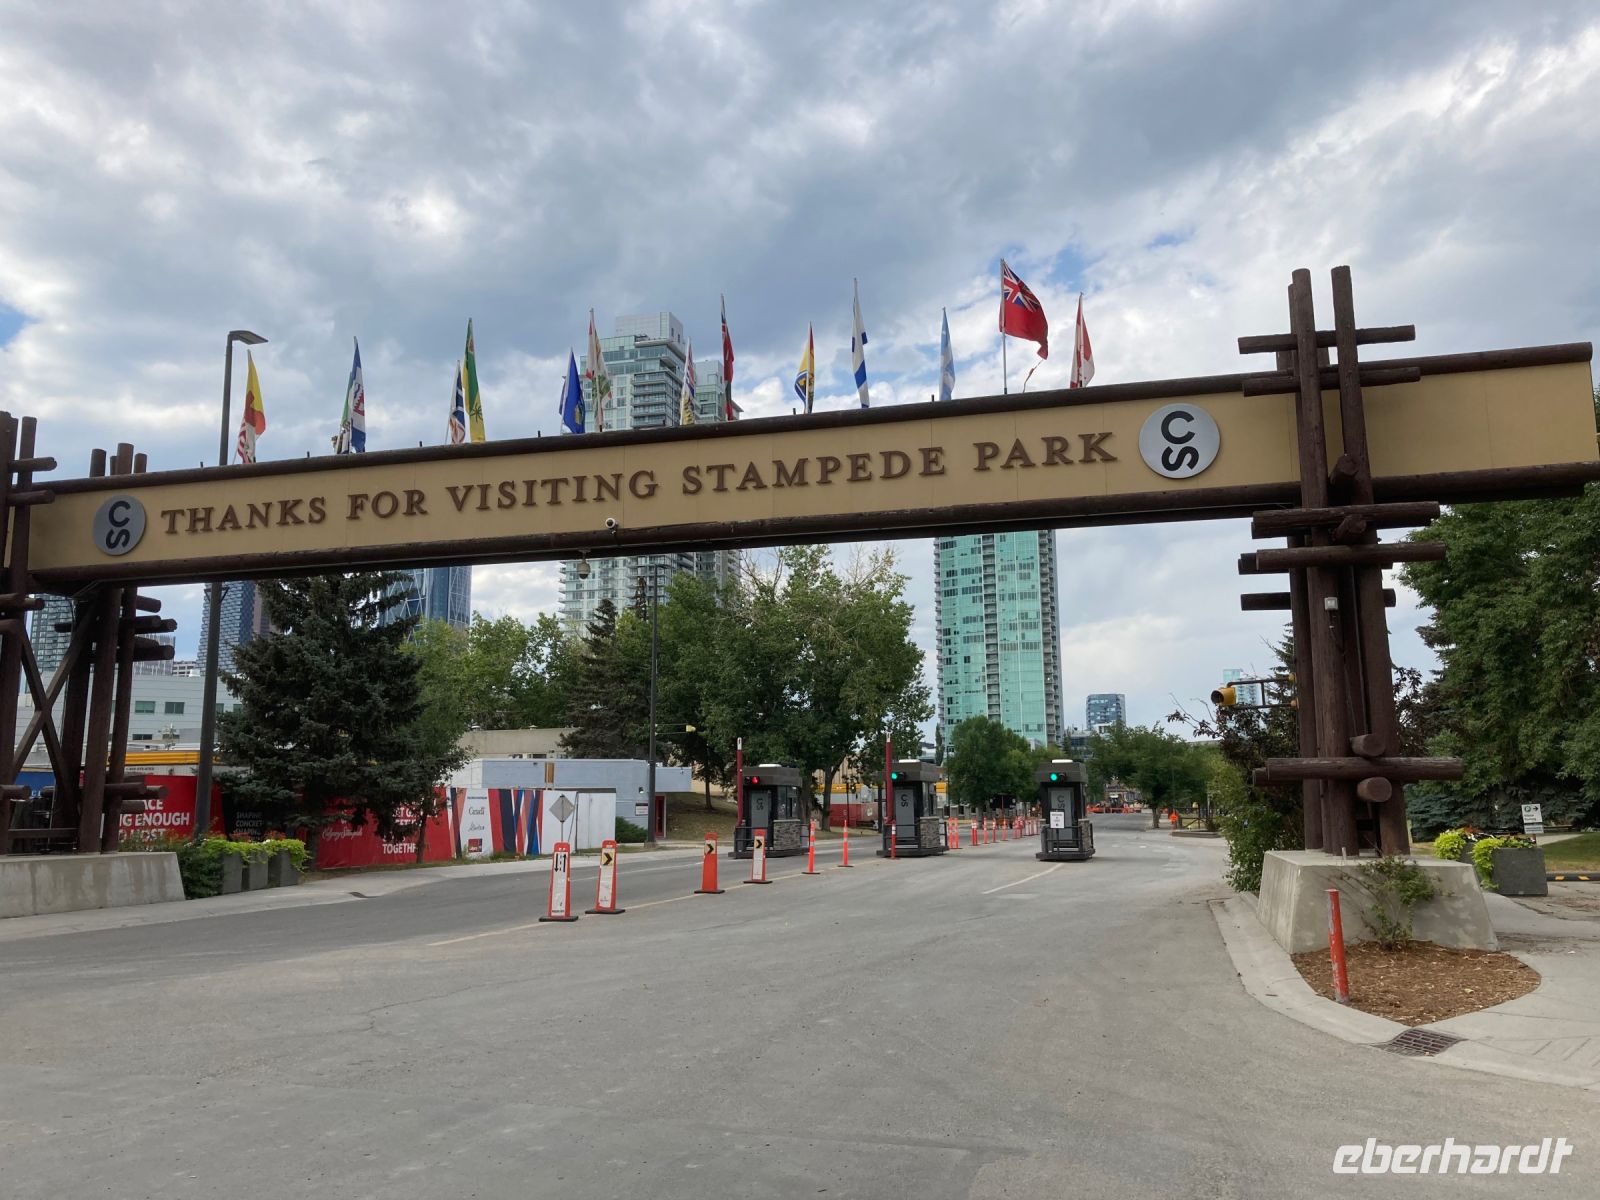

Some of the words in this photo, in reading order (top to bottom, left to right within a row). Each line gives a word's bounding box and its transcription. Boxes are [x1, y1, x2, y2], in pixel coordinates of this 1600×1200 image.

[161, 496, 327, 535] THANKS
[346, 489, 428, 521] FOR
[446, 470, 660, 513] VISITING
[682, 446, 947, 496] STAMPEDE
[973, 431, 1118, 472] PARK
[135, 812, 190, 827] ENOUGH
